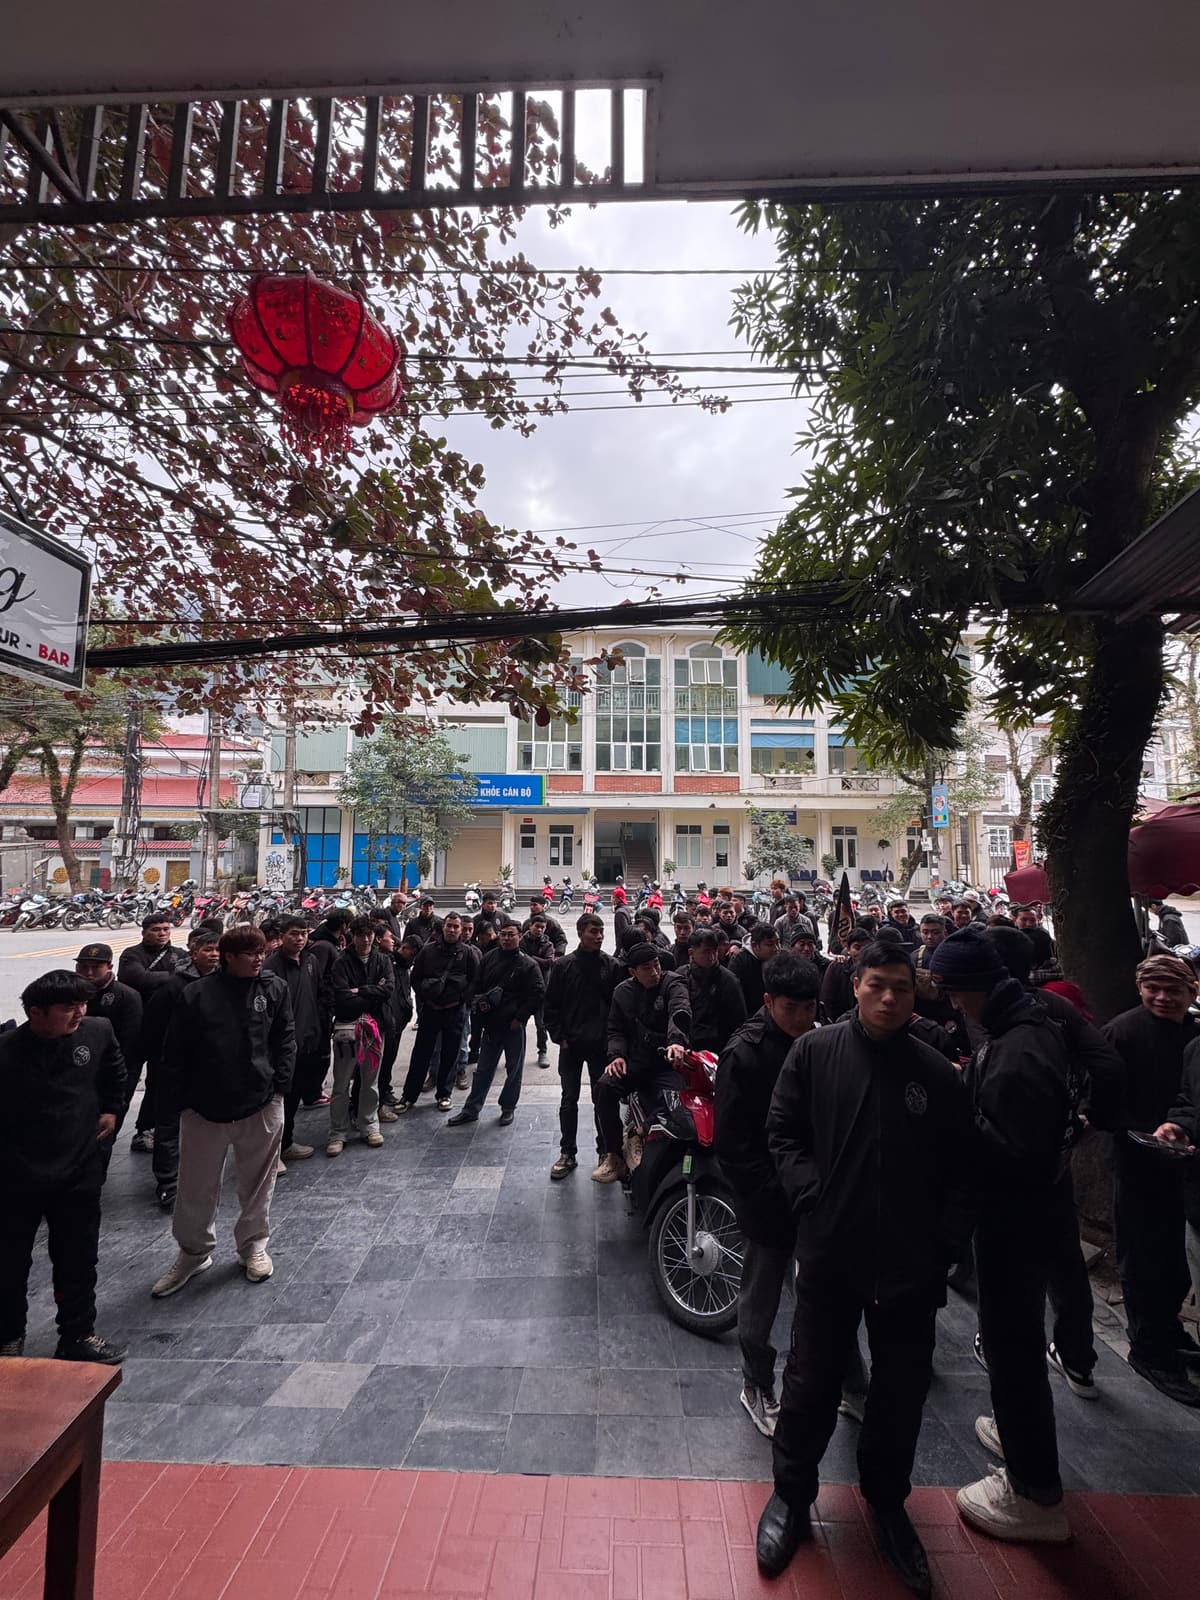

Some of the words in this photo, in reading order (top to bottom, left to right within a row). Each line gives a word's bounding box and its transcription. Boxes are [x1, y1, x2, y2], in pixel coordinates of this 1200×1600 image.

[38, 643, 70, 667] BAR
[502, 786, 519, 797] CÁN
[520, 787, 532, 798] BỘ
